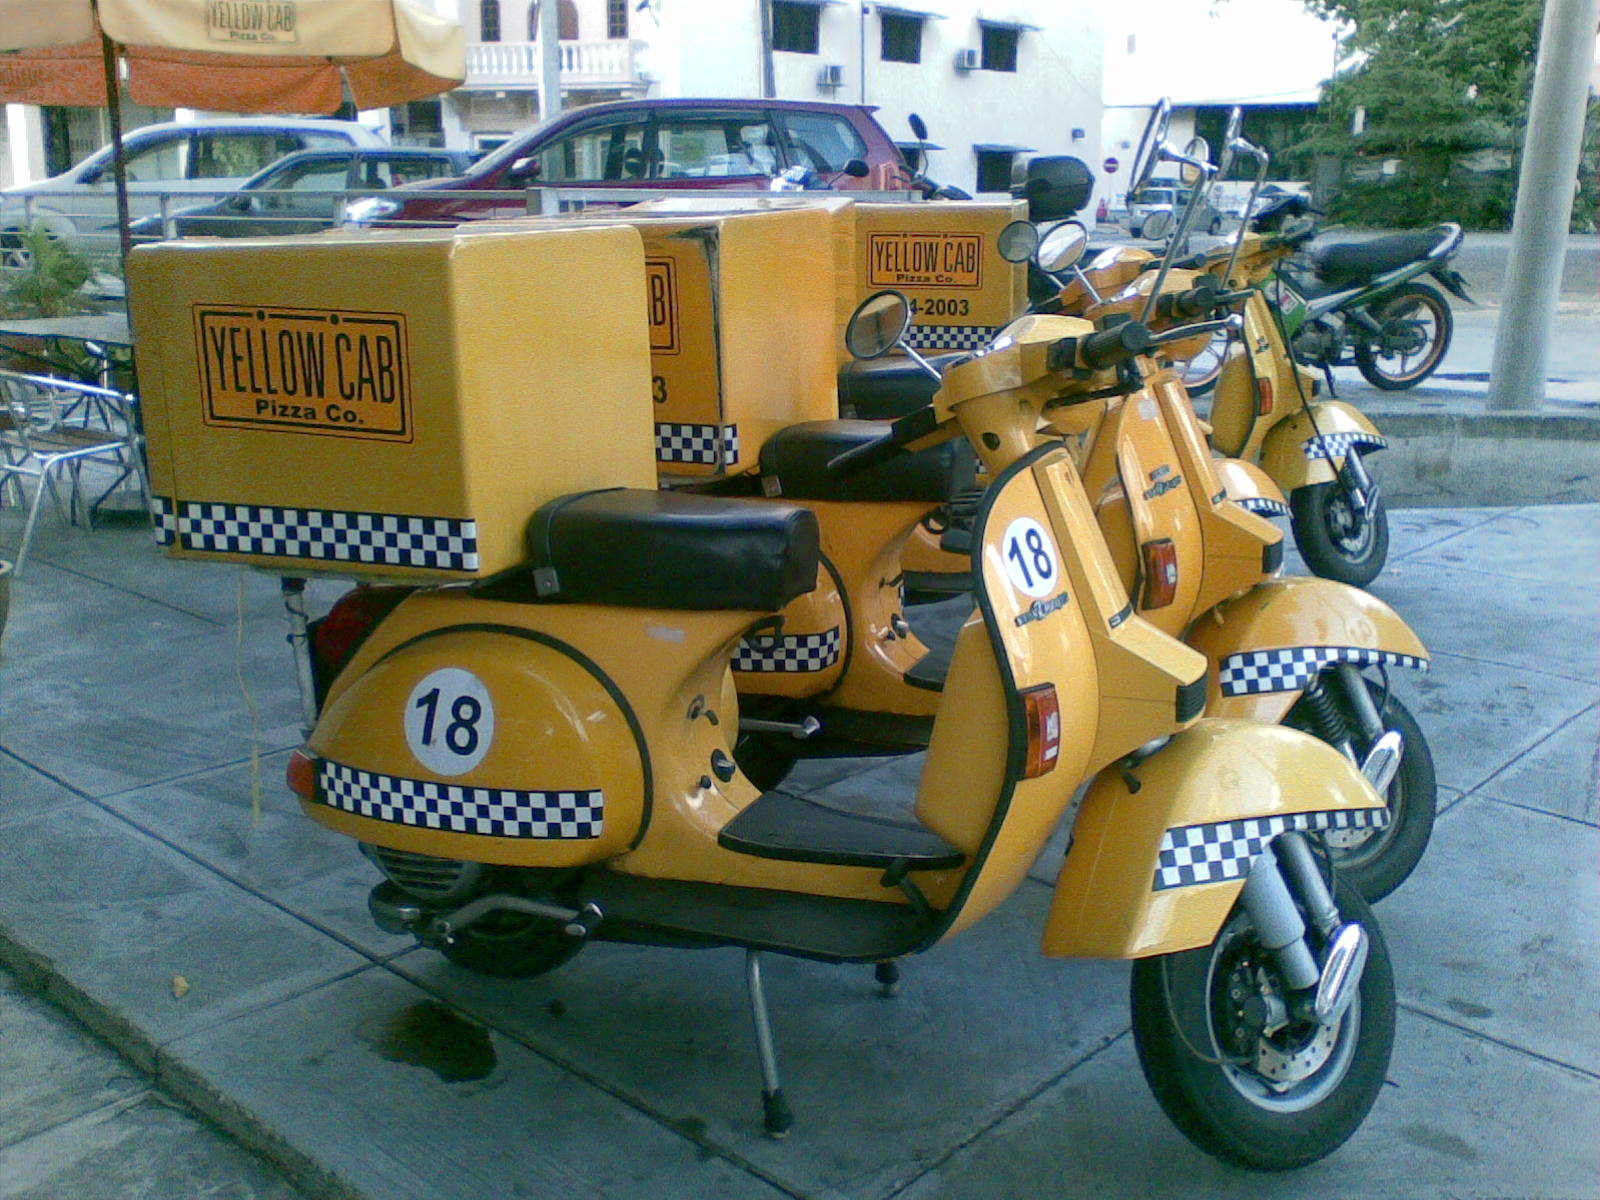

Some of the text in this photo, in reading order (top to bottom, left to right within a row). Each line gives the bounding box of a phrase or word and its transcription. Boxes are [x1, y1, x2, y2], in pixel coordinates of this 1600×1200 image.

[208, 1, 296, 32] YELLOW CAB
[875, 241, 976, 273] YELLOW CAB
[896, 273, 957, 283] Pizza Co.
[210, 326, 396, 404] YELLOW CAB
[255, 399, 365, 425] Pizza Co.
[1008, 528, 1053, 589] 18
[415, 687, 482, 756] 18
